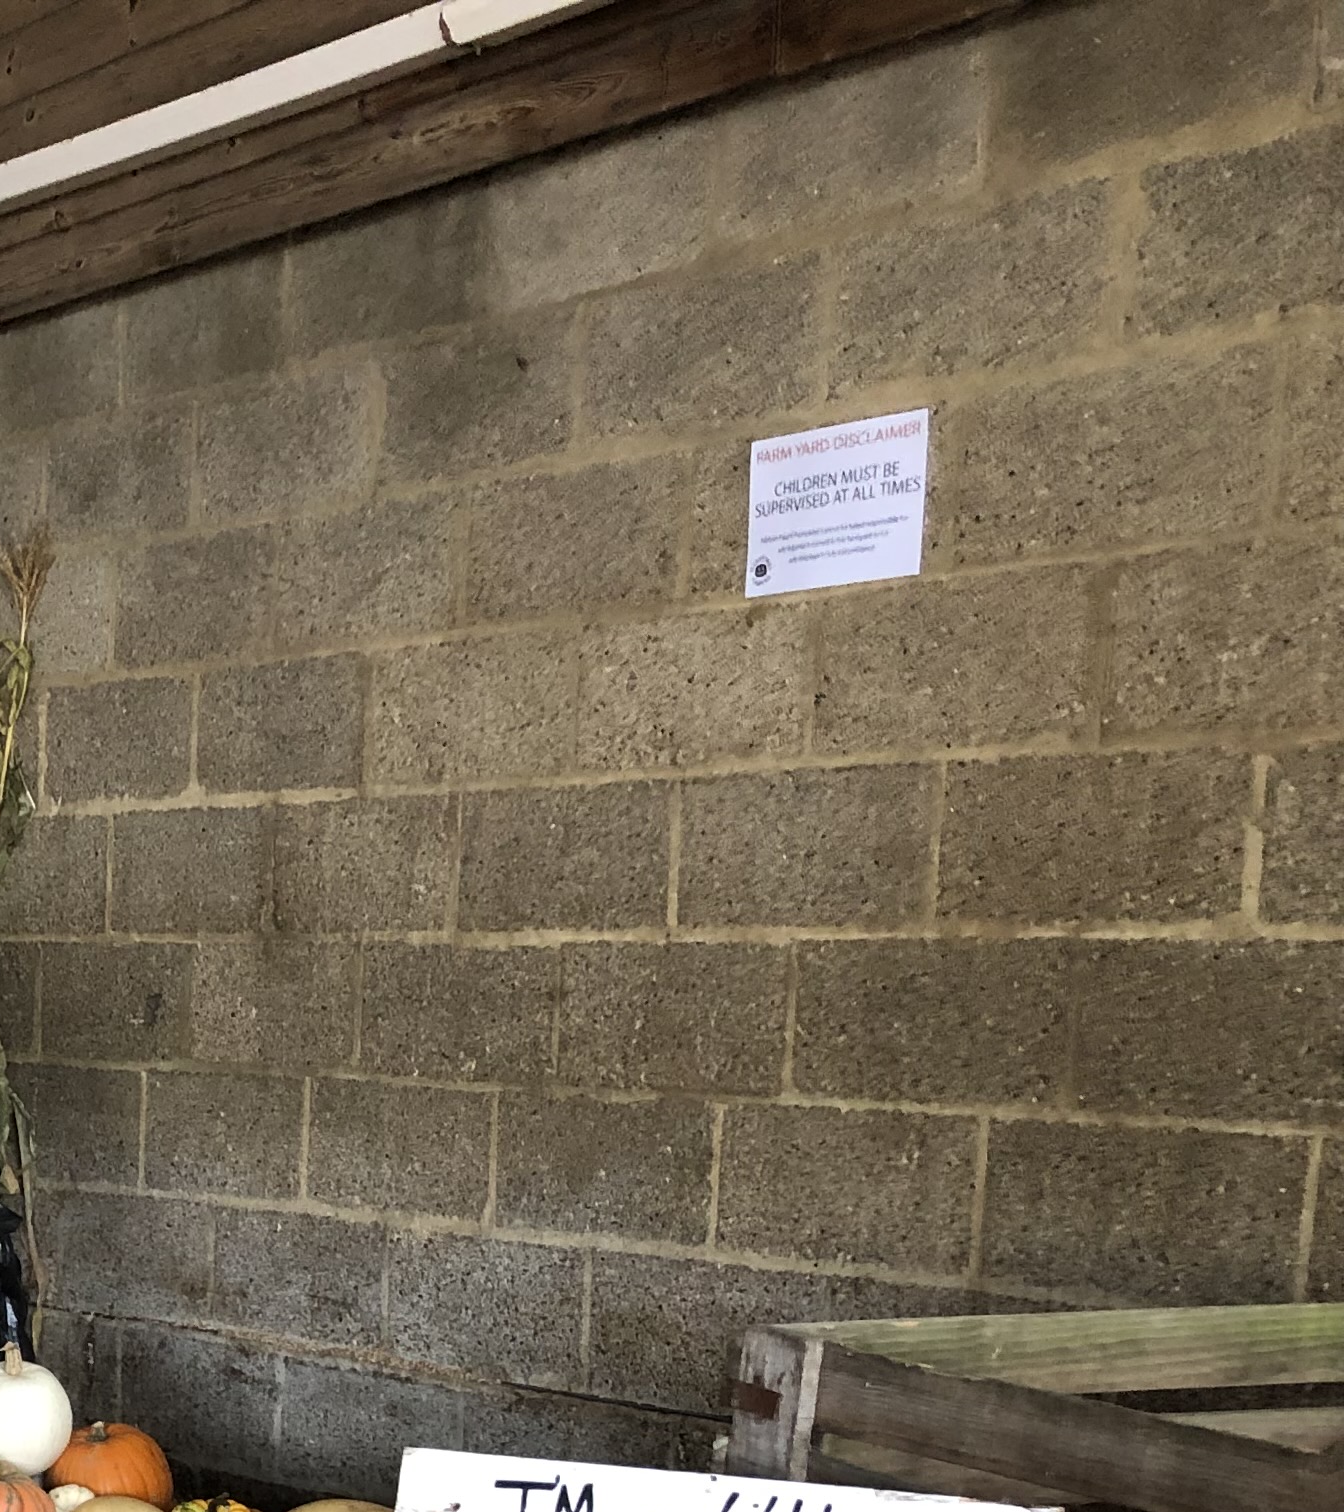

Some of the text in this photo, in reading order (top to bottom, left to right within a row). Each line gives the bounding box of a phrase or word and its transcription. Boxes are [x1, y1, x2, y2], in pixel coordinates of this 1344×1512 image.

[796, 437, 831, 457] YARD
[834, 421, 920, 450] DISCLAIMER
[754, 476, 921, 518] SUPERVISED AT ALL TIMES
[774, 460, 900, 498] CHILDREN MUST BE
